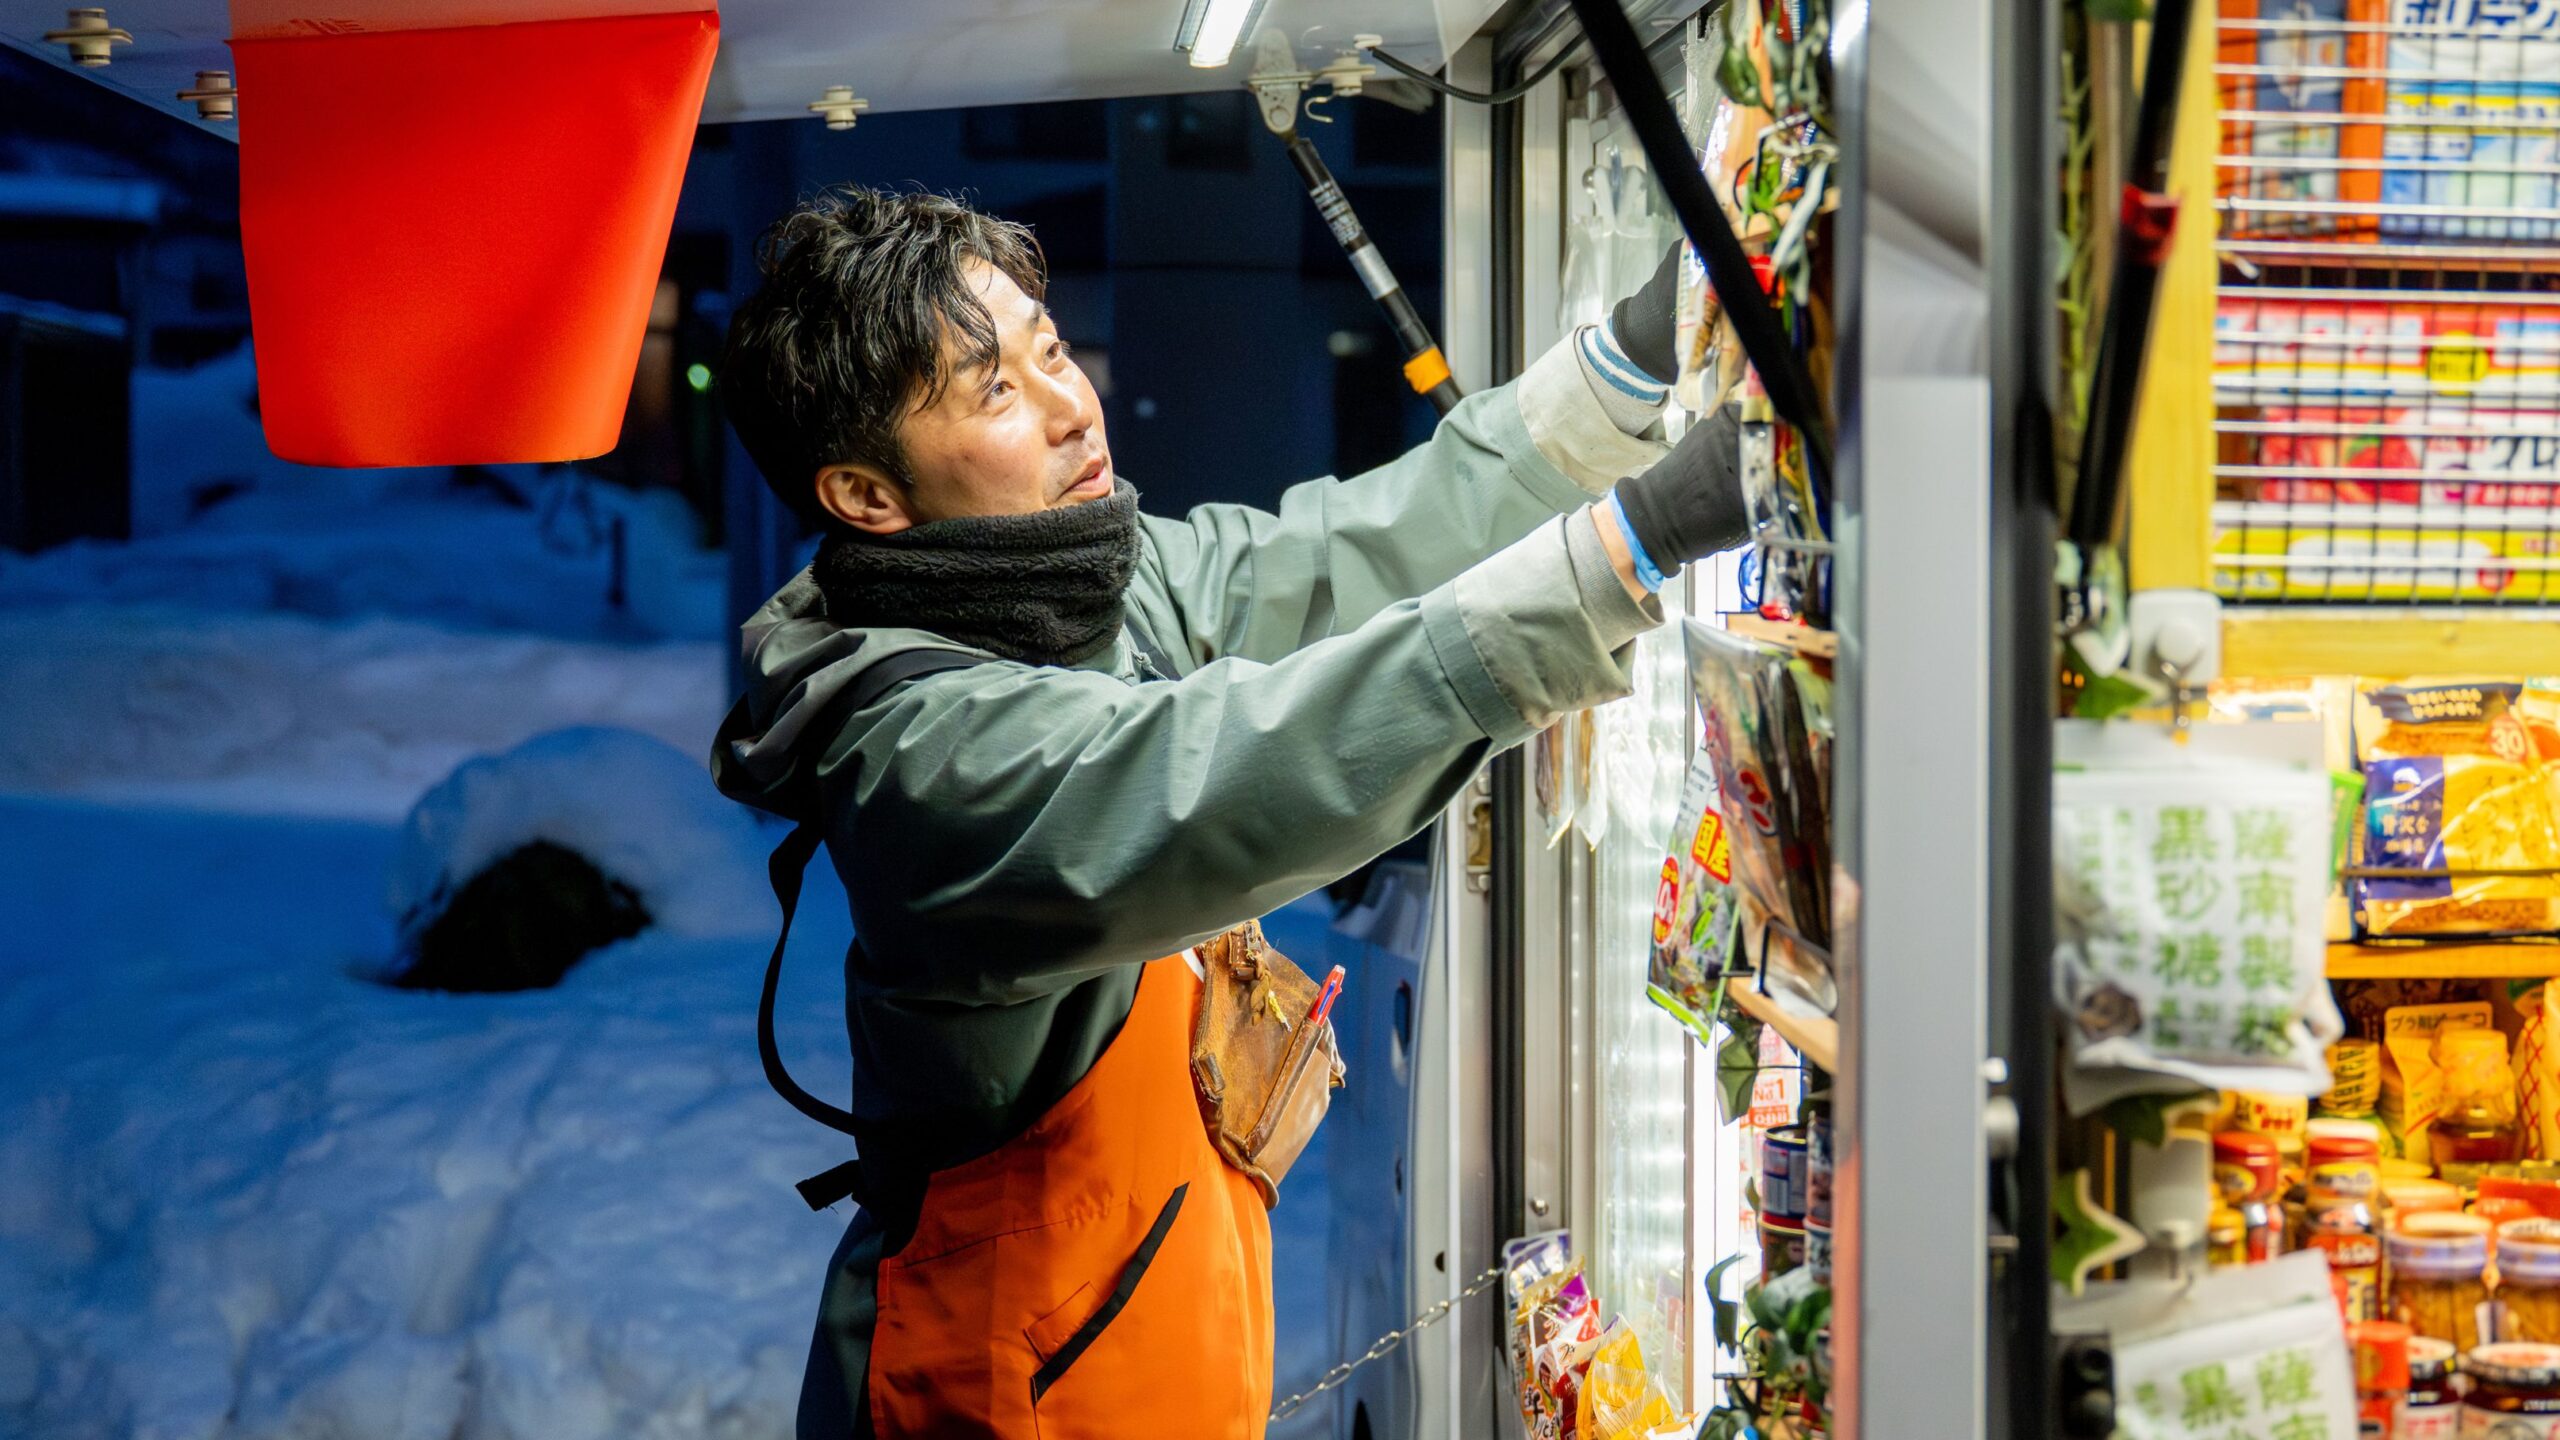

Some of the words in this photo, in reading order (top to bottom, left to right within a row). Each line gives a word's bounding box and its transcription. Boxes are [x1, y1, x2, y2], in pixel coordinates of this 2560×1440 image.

[2490, 727, 2527, 758] 30
[1693, 811, 1731, 878] 国産
[2152, 806, 2222, 988] 黒砂糖
